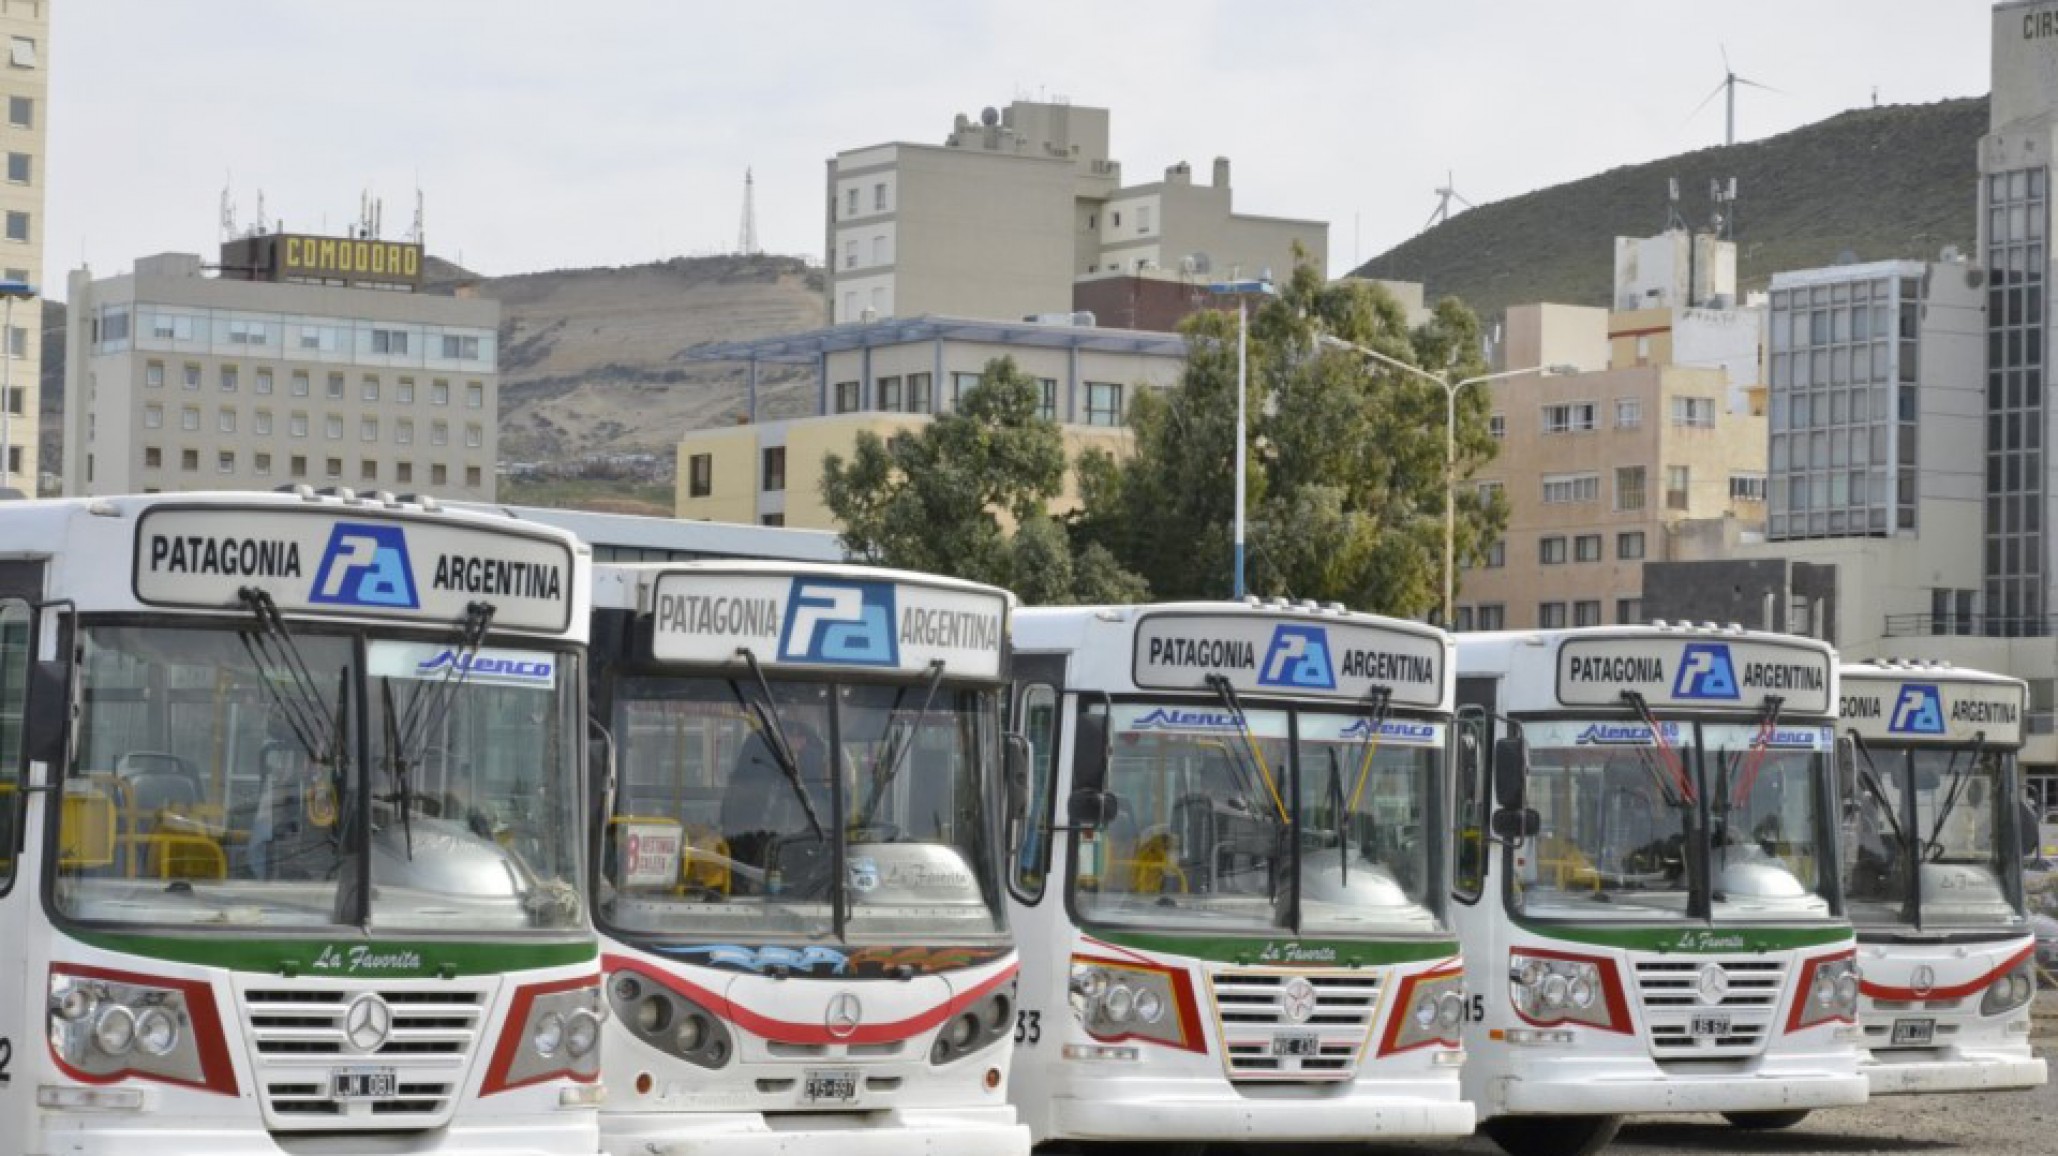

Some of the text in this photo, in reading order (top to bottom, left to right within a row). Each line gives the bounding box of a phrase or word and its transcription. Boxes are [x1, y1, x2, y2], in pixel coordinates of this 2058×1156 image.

[2023, 11, 2058, 39] CIR
[286, 237, 418, 276] COMODORO
[150, 534, 301, 578] PATAGONIA
[433, 554, 560, 600] ARGENTINA
[659, 594, 778, 638] PATAGONIA
[899, 606, 998, 651] ARGENTINA
[1150, 636, 1255, 669] PATAGONIA
[1341, 649, 1433, 684] ARGENTINA
[1570, 656, 1664, 683] PATAGONIA
[1742, 662, 1823, 691] ARGENTINA
[1952, 700, 2016, 723] ARGENTINA
[1260, 941, 1336, 962] La Favorita
[1677, 930, 1695, 948] La
[313, 945, 420, 973] La Favorita
